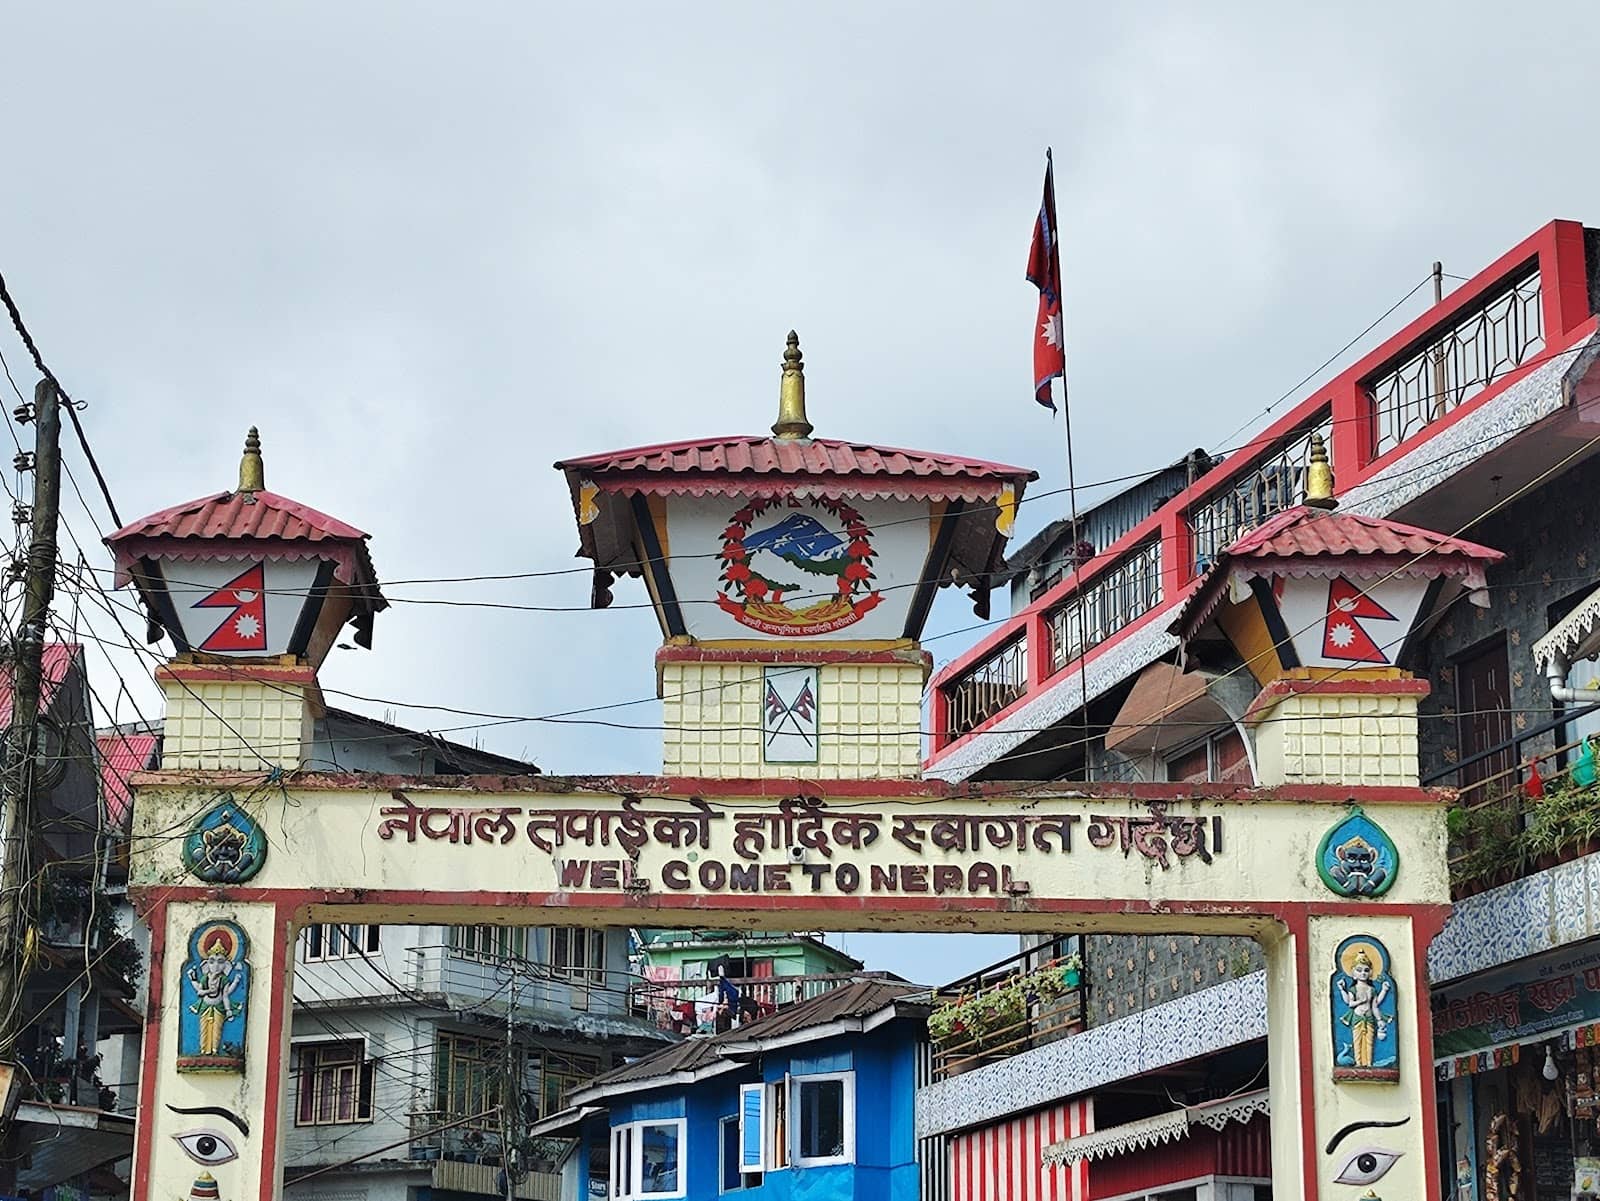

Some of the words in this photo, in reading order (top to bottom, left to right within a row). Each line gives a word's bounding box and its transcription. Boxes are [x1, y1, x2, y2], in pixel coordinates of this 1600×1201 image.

[378, 788, 522, 845] नेपाल
[892, 815, 1080, 854] स्वागत
[559, 859, 792, 893] WELCOME
[802, 862, 860, 893] TO
[871, 861, 1029, 896] NEPAL
